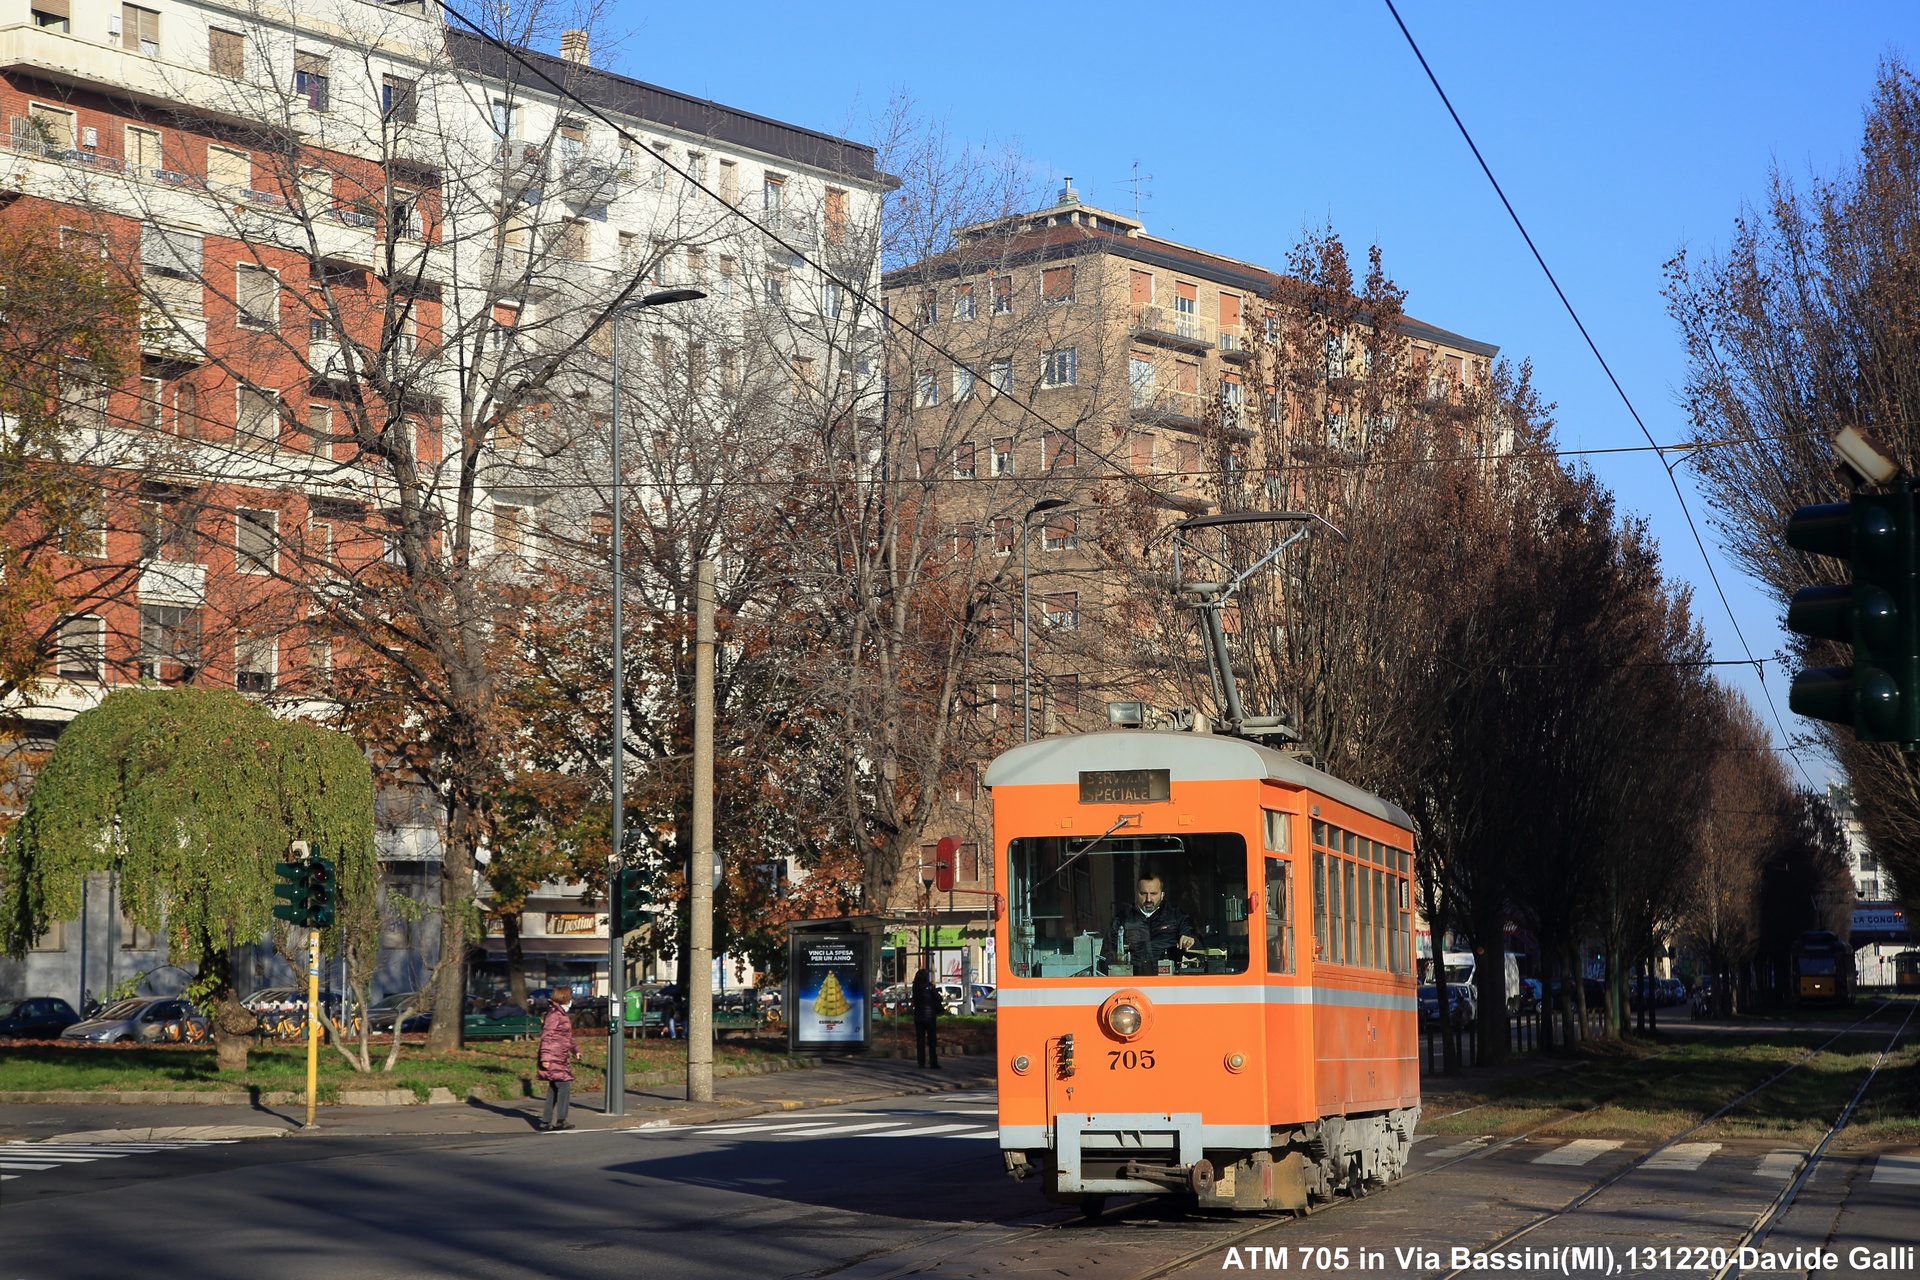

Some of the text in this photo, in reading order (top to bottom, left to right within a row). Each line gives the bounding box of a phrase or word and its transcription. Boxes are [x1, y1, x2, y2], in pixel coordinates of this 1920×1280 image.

[1086, 787, 1149, 801] SPECIALE
[1853, 916, 1865, 924] LA
[1107, 1049, 1156, 1070] 705
